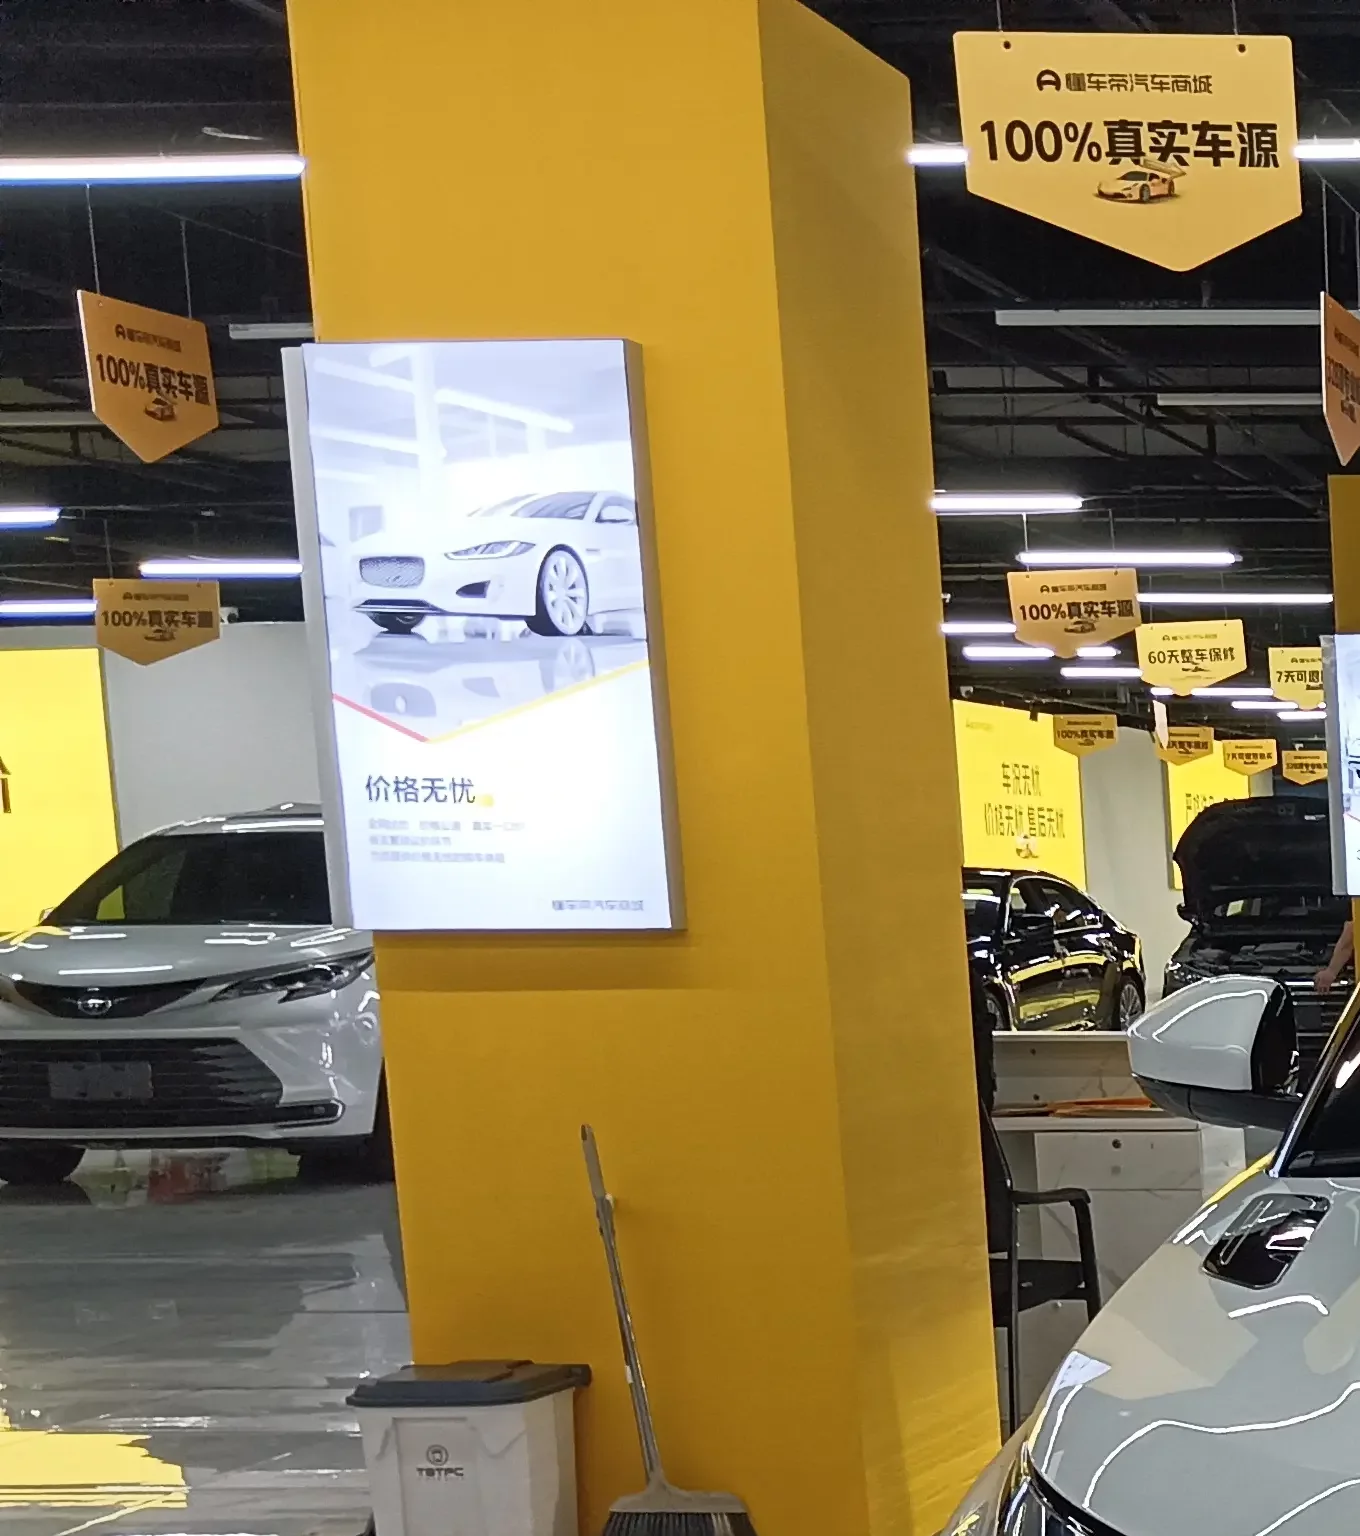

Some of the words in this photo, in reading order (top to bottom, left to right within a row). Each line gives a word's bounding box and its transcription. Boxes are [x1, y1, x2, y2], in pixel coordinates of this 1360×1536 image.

[1065, 72, 1213, 95] 懂车帝汽车商城
[979, 118, 1280, 169] 100%真实车源
[1276, 670, 1323, 683] 7天可退
[365, 775, 476, 804] 价格无忧
